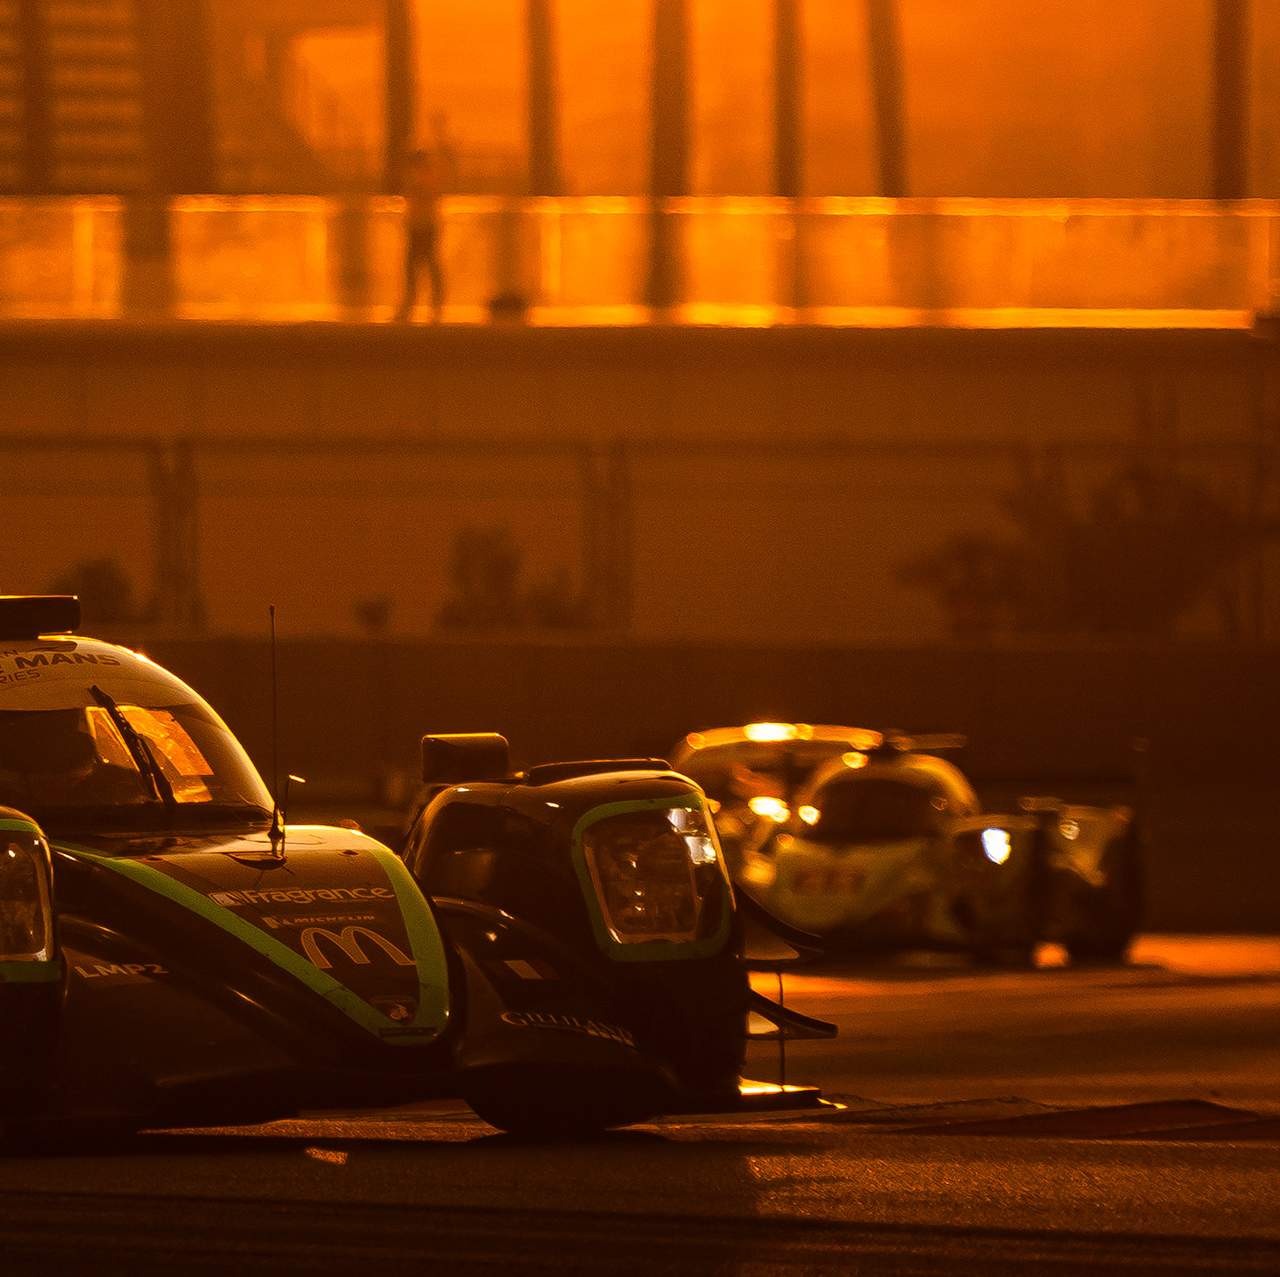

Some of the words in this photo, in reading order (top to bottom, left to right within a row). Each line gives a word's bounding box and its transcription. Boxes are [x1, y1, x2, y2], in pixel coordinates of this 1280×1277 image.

[14, 653, 121, 670] MANS
[241, 887, 395, 905] Fragrance
[294, 915, 375, 923] MICHELIN
[73, 963, 169, 978] LMP2
